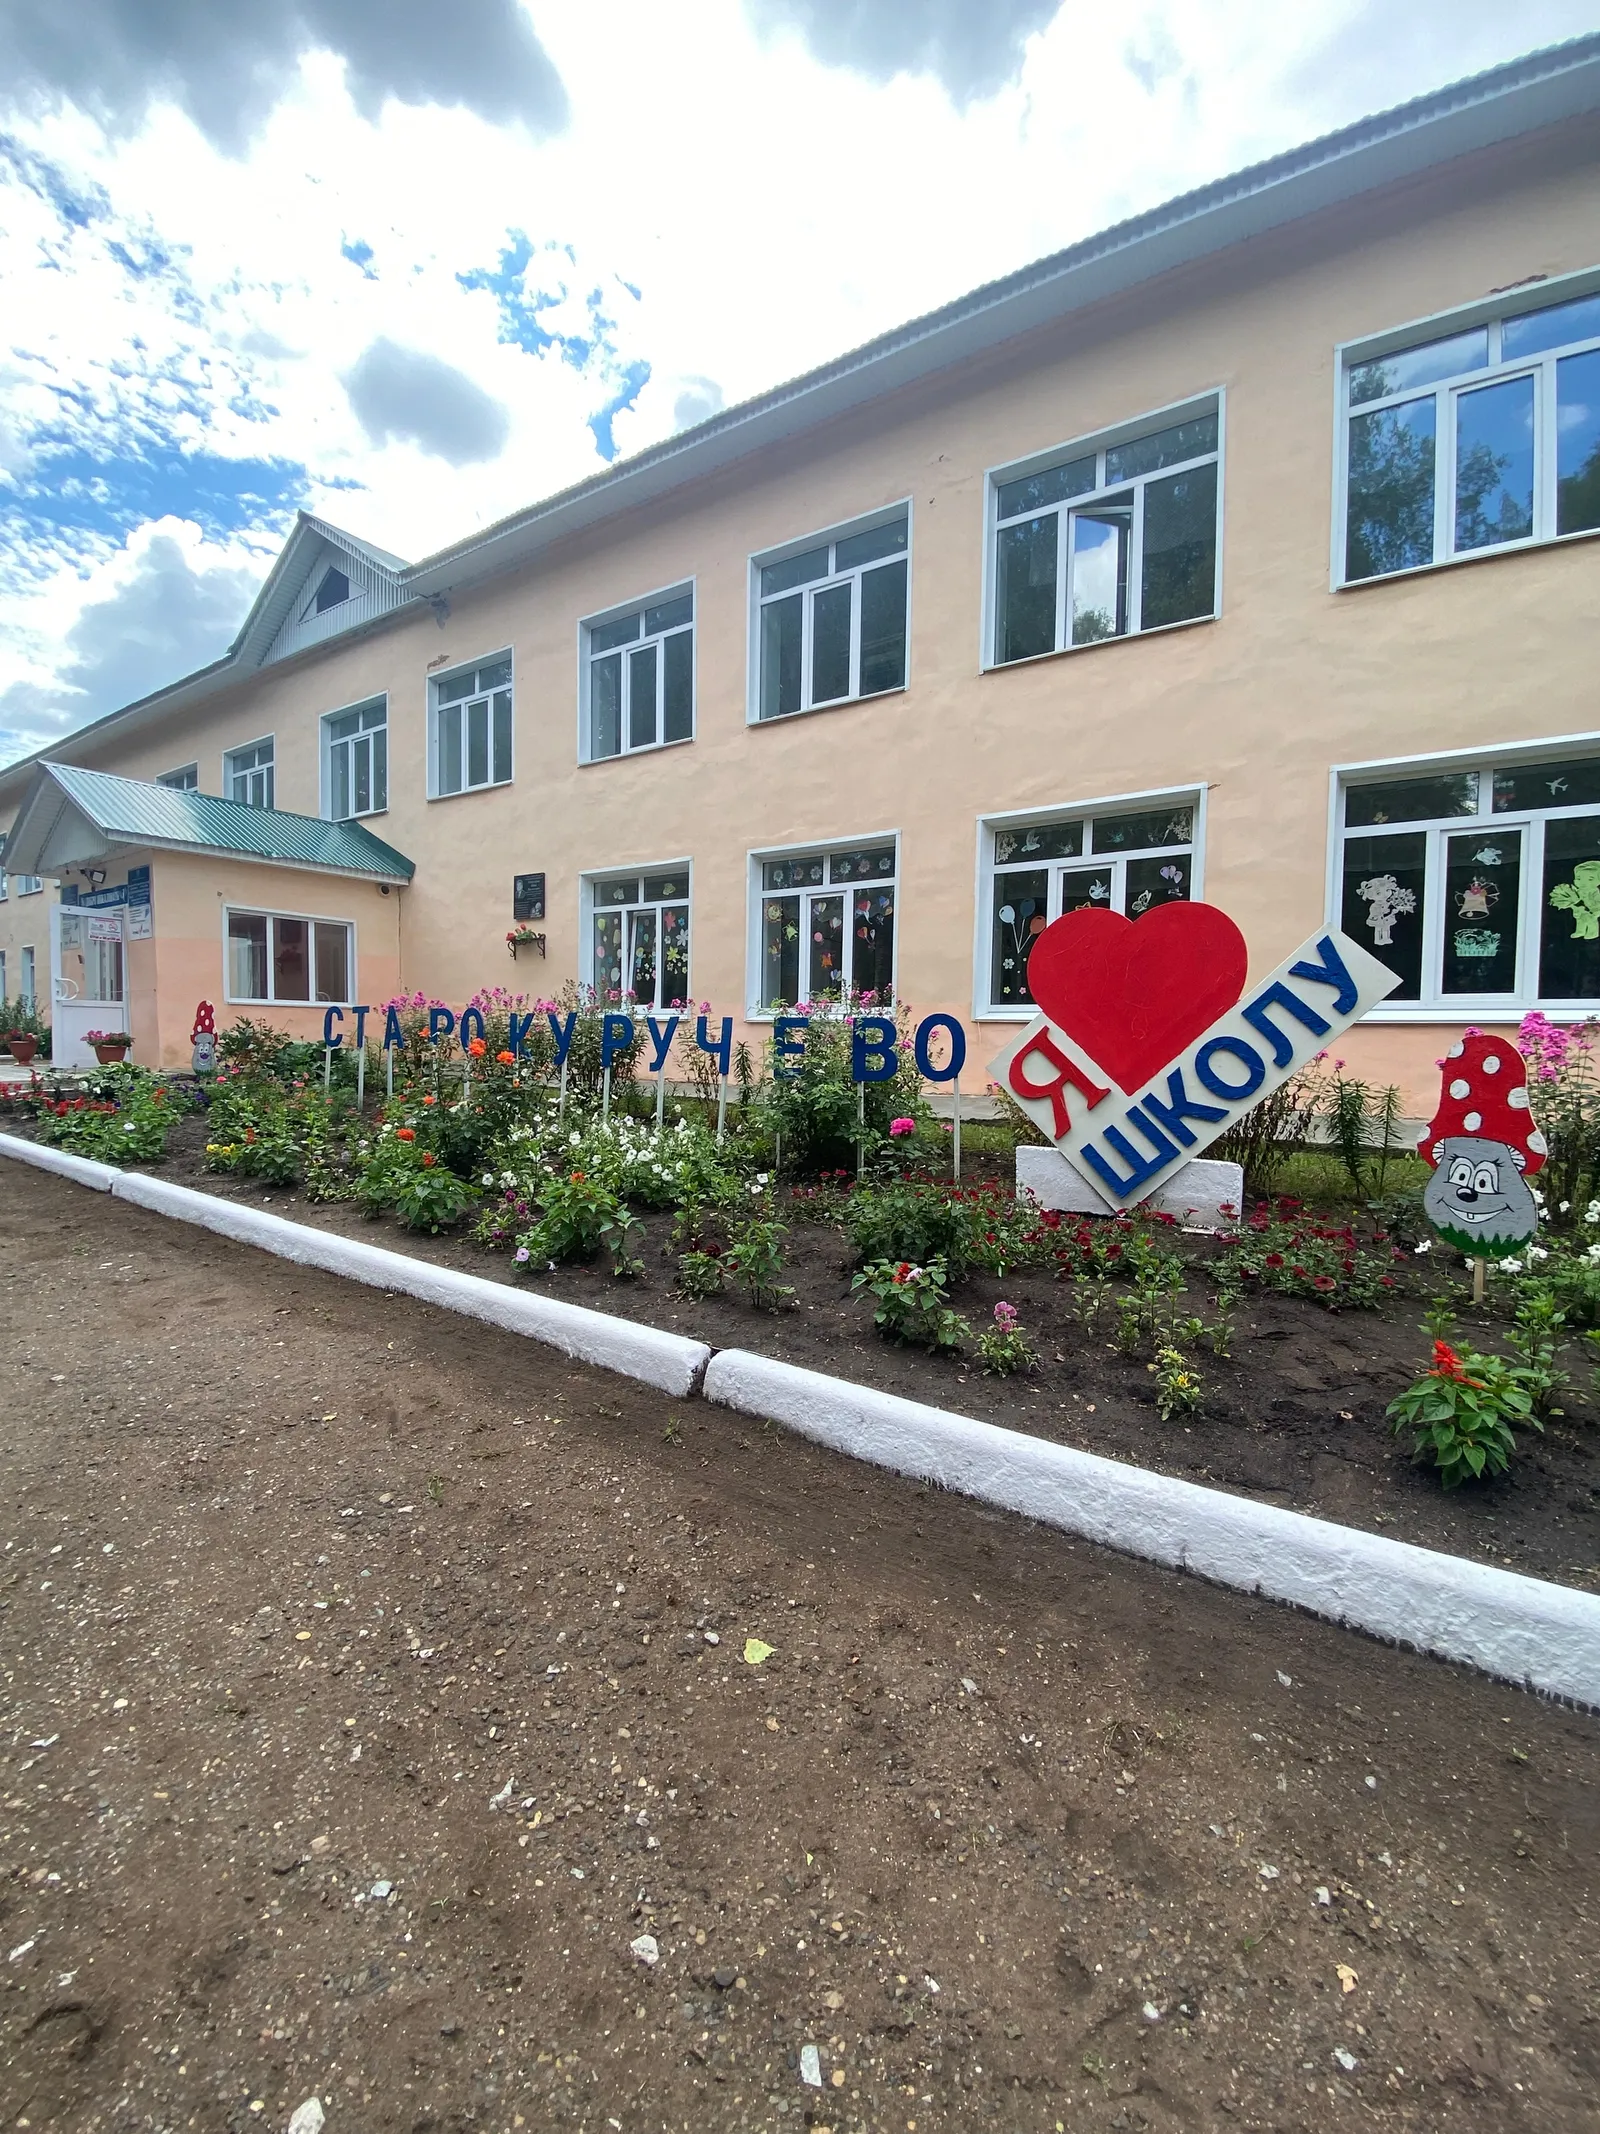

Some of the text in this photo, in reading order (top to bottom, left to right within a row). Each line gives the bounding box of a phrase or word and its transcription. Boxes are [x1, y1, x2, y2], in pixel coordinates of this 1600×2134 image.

[323, 1005, 967, 1083] СТАРОКУРУЧЕВО
[1008, 1025, 1112, 1140] Я
[1080, 935, 1359, 1200] ШКОЛУ
